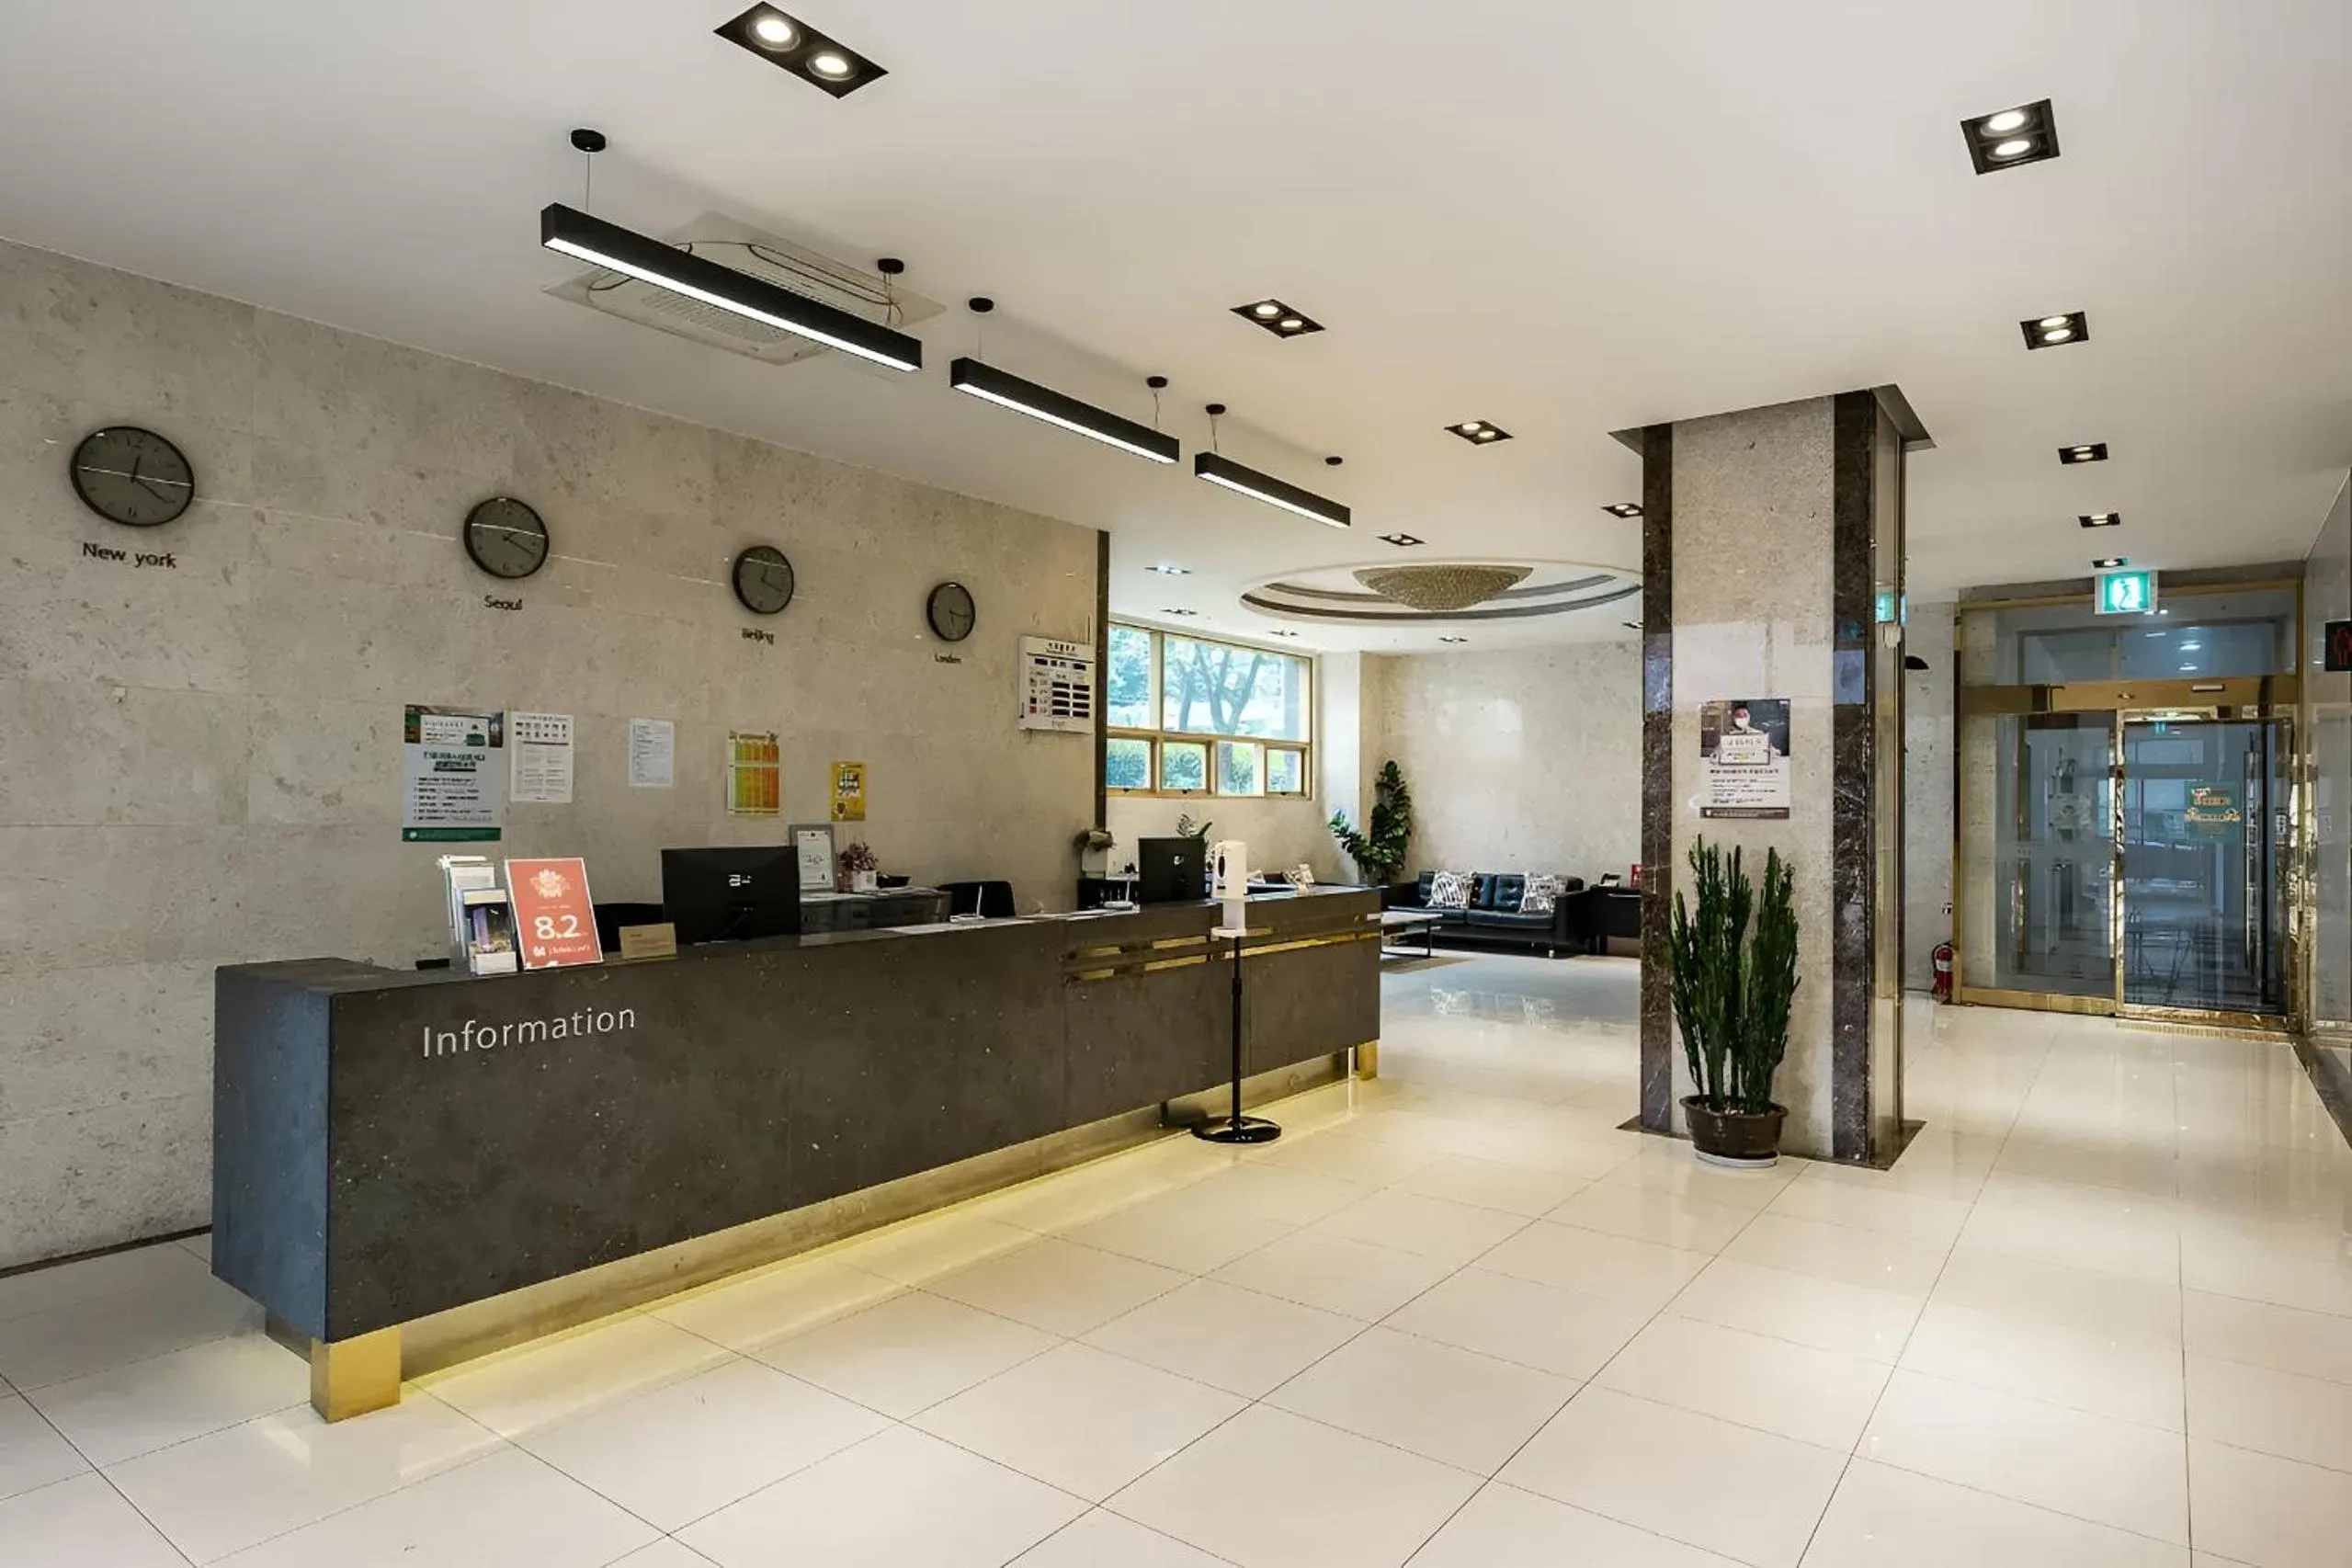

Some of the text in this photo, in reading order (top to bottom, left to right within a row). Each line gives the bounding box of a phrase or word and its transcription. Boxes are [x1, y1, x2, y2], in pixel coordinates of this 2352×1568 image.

[83, 542, 176, 568] New york
[484, 595, 522, 610] Seoul
[534, 915, 581, 939] 8.2
[424, 1007, 635, 1058] Information
